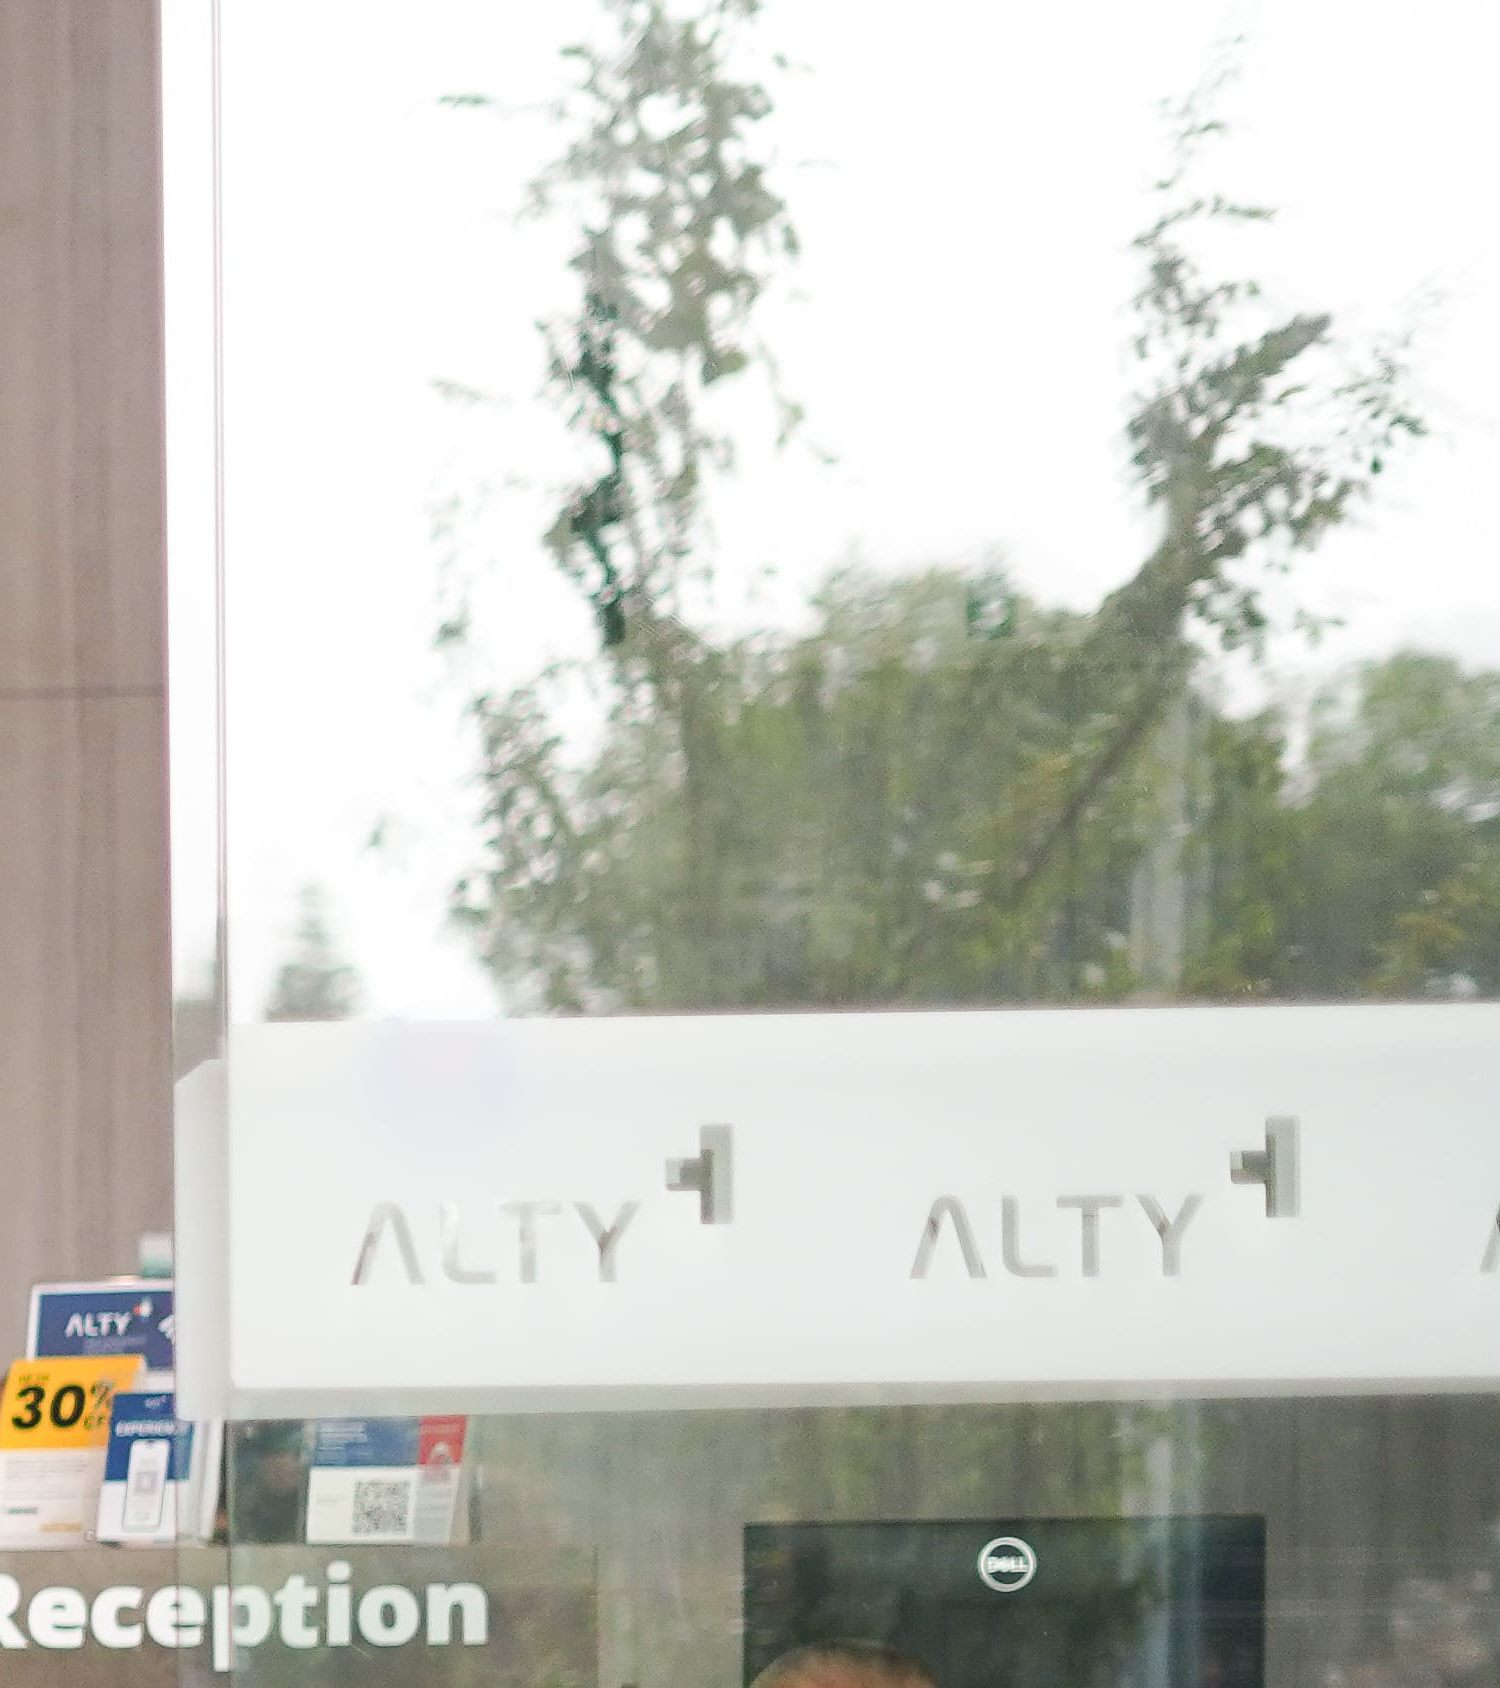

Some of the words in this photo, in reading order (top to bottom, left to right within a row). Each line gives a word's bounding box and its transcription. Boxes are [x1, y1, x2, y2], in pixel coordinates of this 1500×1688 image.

[351, 1199, 643, 1286] ALTY
[909, 1193, 1203, 1279] ALTY
[64, 1312, 132, 1338] ALTY
[987, 1556, 1029, 1573] DELL
